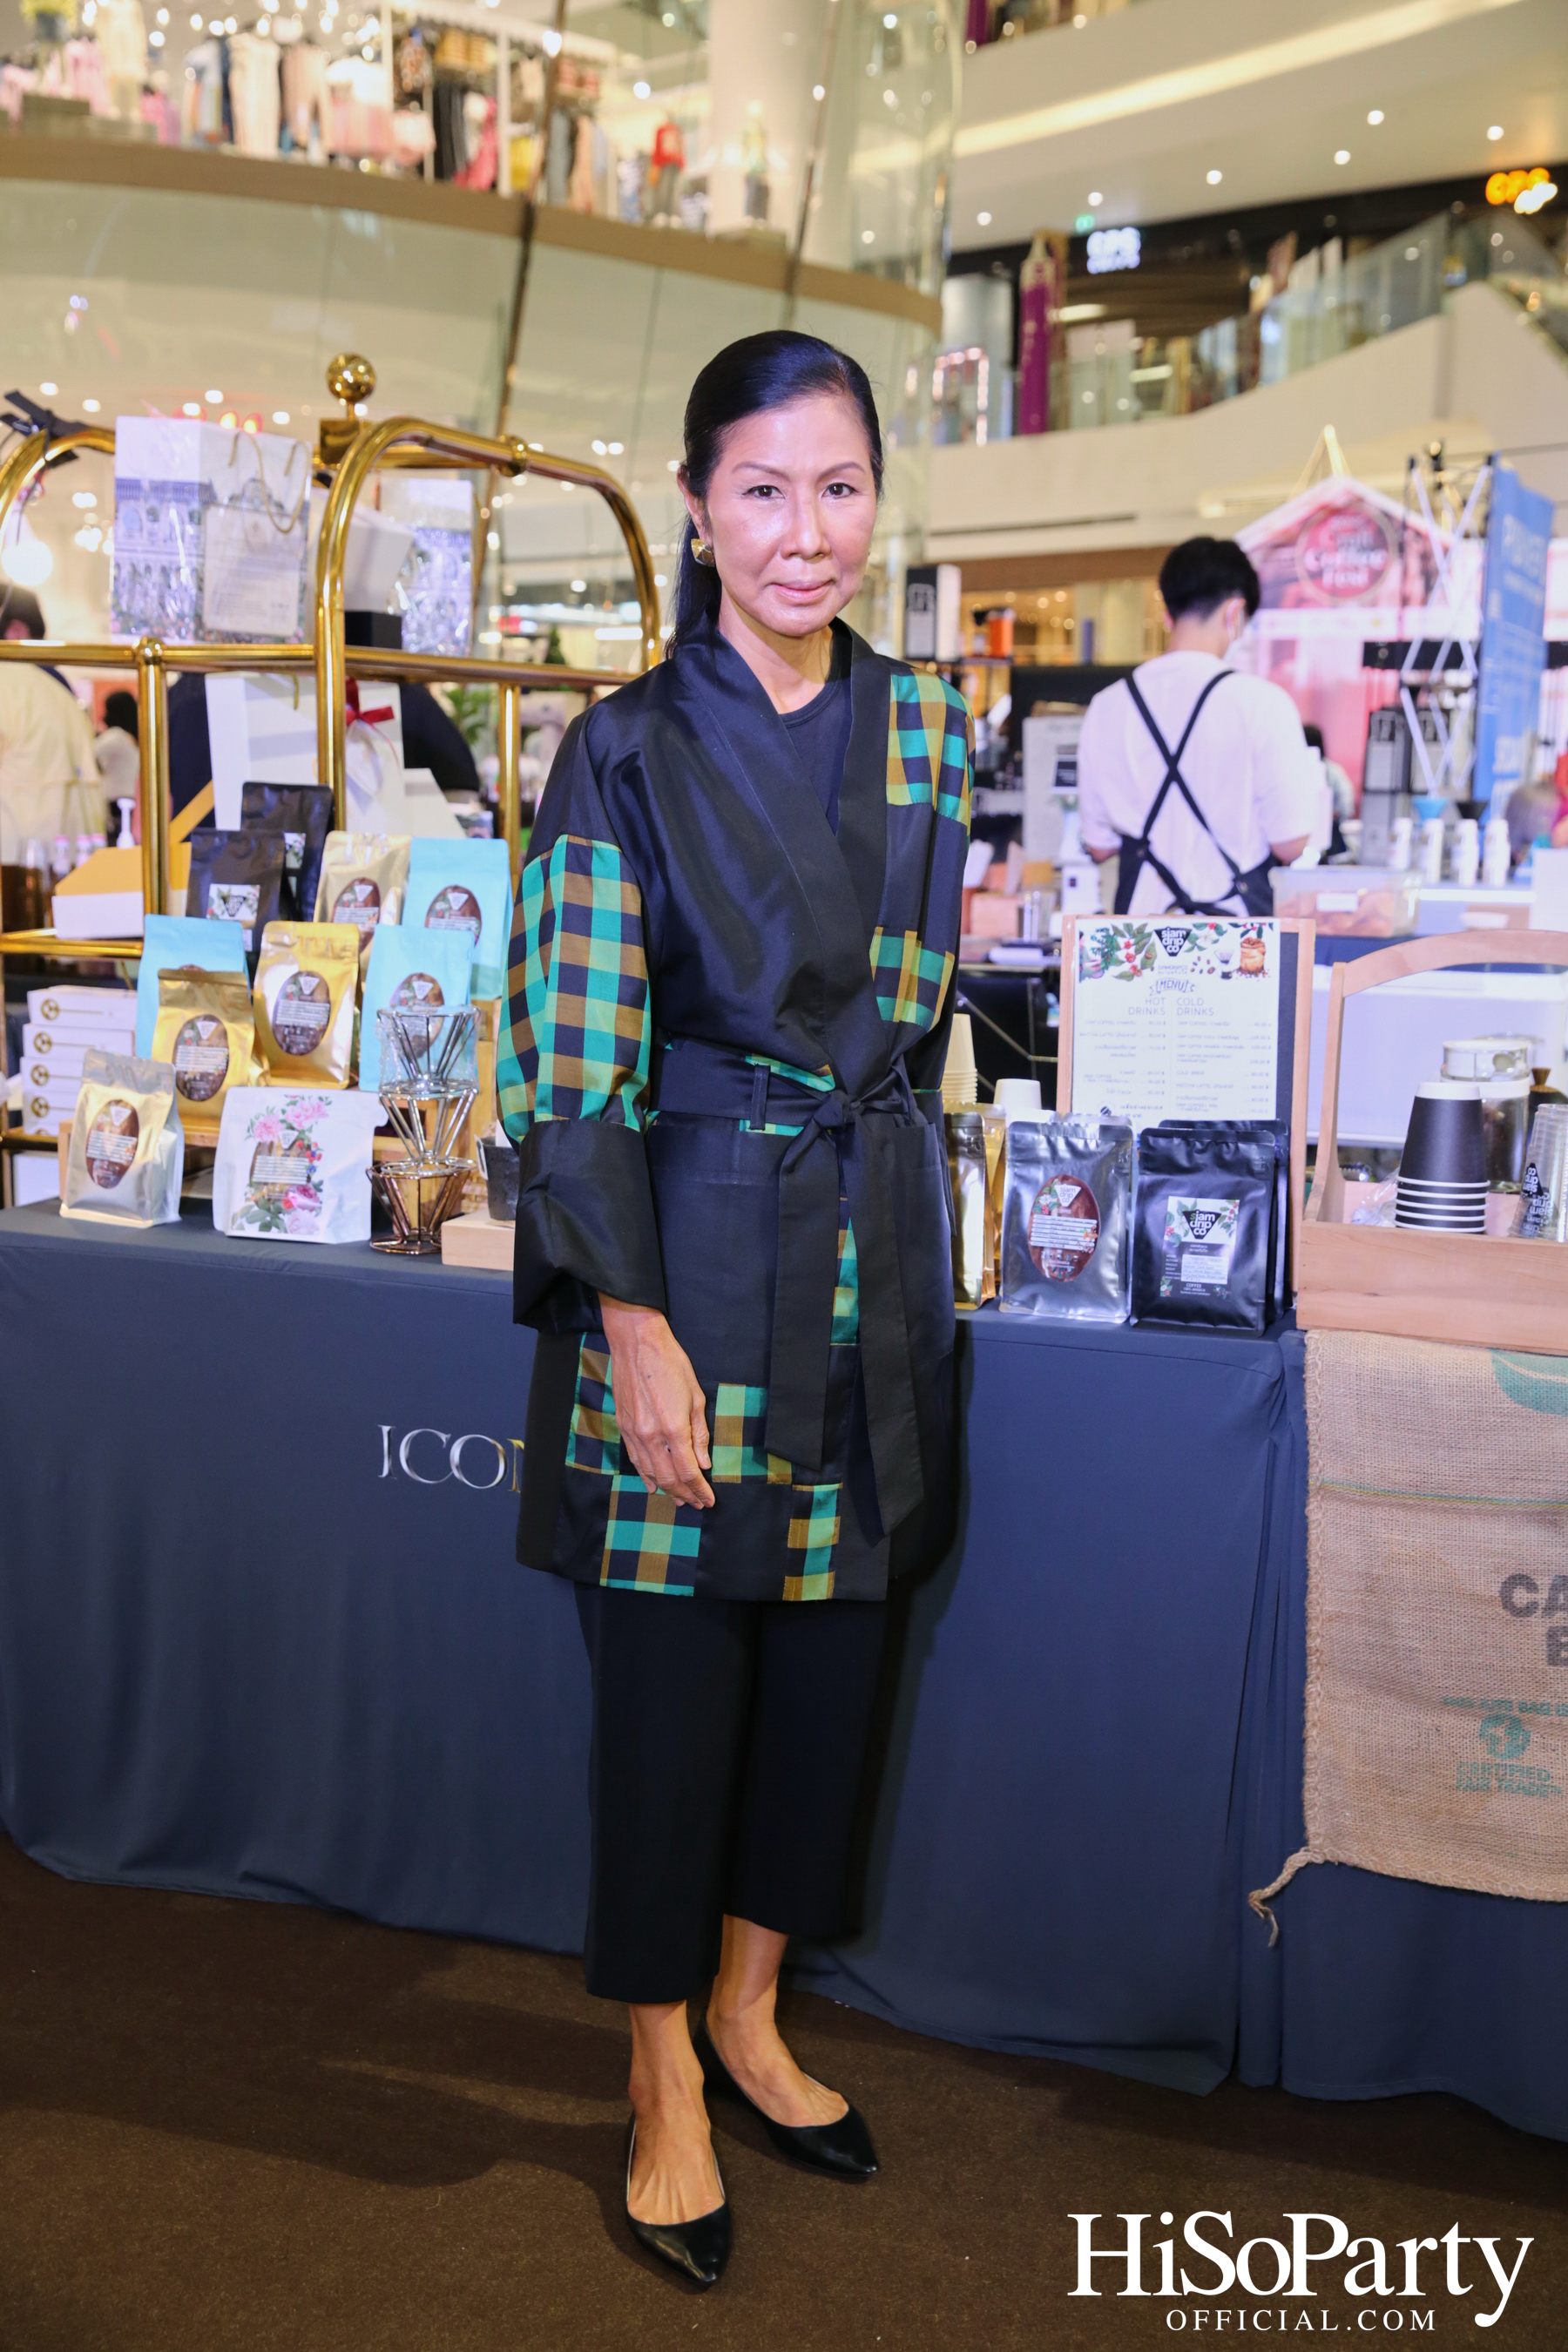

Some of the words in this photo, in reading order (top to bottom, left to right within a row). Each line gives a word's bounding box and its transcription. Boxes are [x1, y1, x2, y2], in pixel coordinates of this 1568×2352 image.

[1160, 927, 1186, 938] siam
[1161, 936, 1185, 947] drip
[1166, 944, 1179, 953] co
[1159, 979, 1186, 991] MENU
[1145, 997, 1166, 1005] HOT
[1176, 997, 1204, 1006] COLD
[1128, 1006, 1166, 1016] DRINKS
[1176, 1007, 1214, 1017] DRINKS
[1190, 1210, 1215, 1221] siam
[1189, 1220, 1212, 1229] drip
[1518, 1700, 1551, 1716] BAG
[1456, 1761, 1551, 1782] CERTIFIED
[1456, 1777, 1491, 1792] FAIR
